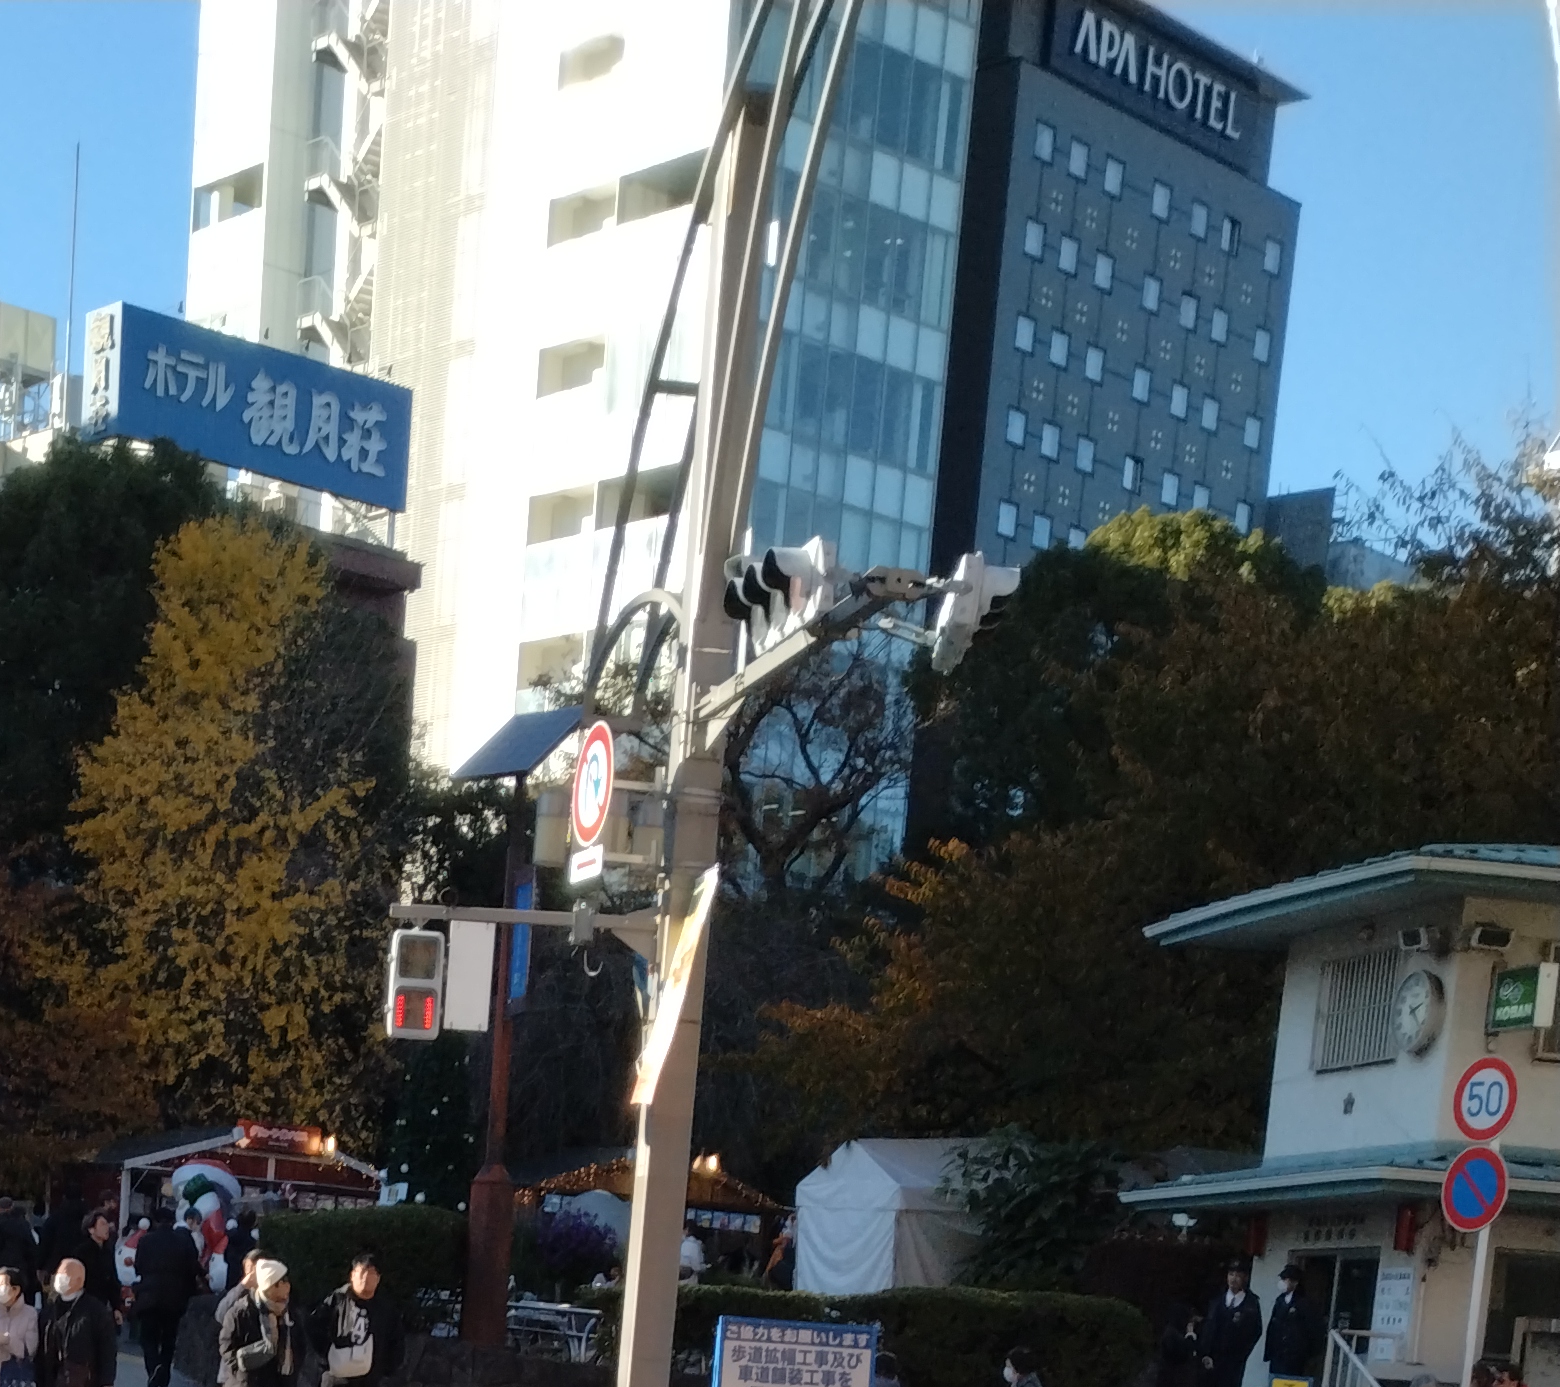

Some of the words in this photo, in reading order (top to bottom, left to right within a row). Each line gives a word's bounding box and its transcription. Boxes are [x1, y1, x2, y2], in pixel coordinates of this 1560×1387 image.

[1074, 9, 1137, 84] APA
[1144, 46, 1240, 139] HOTEL
[144, 343, 235, 412] ホテル
[243, 368, 387, 477] 観月荘
[1467, 1080, 1503, 1117] 50
[726, 1324, 870, 1347] ご協力をお願いします
[731, 1345, 863, 1369] 歩道拡幅工事及び
